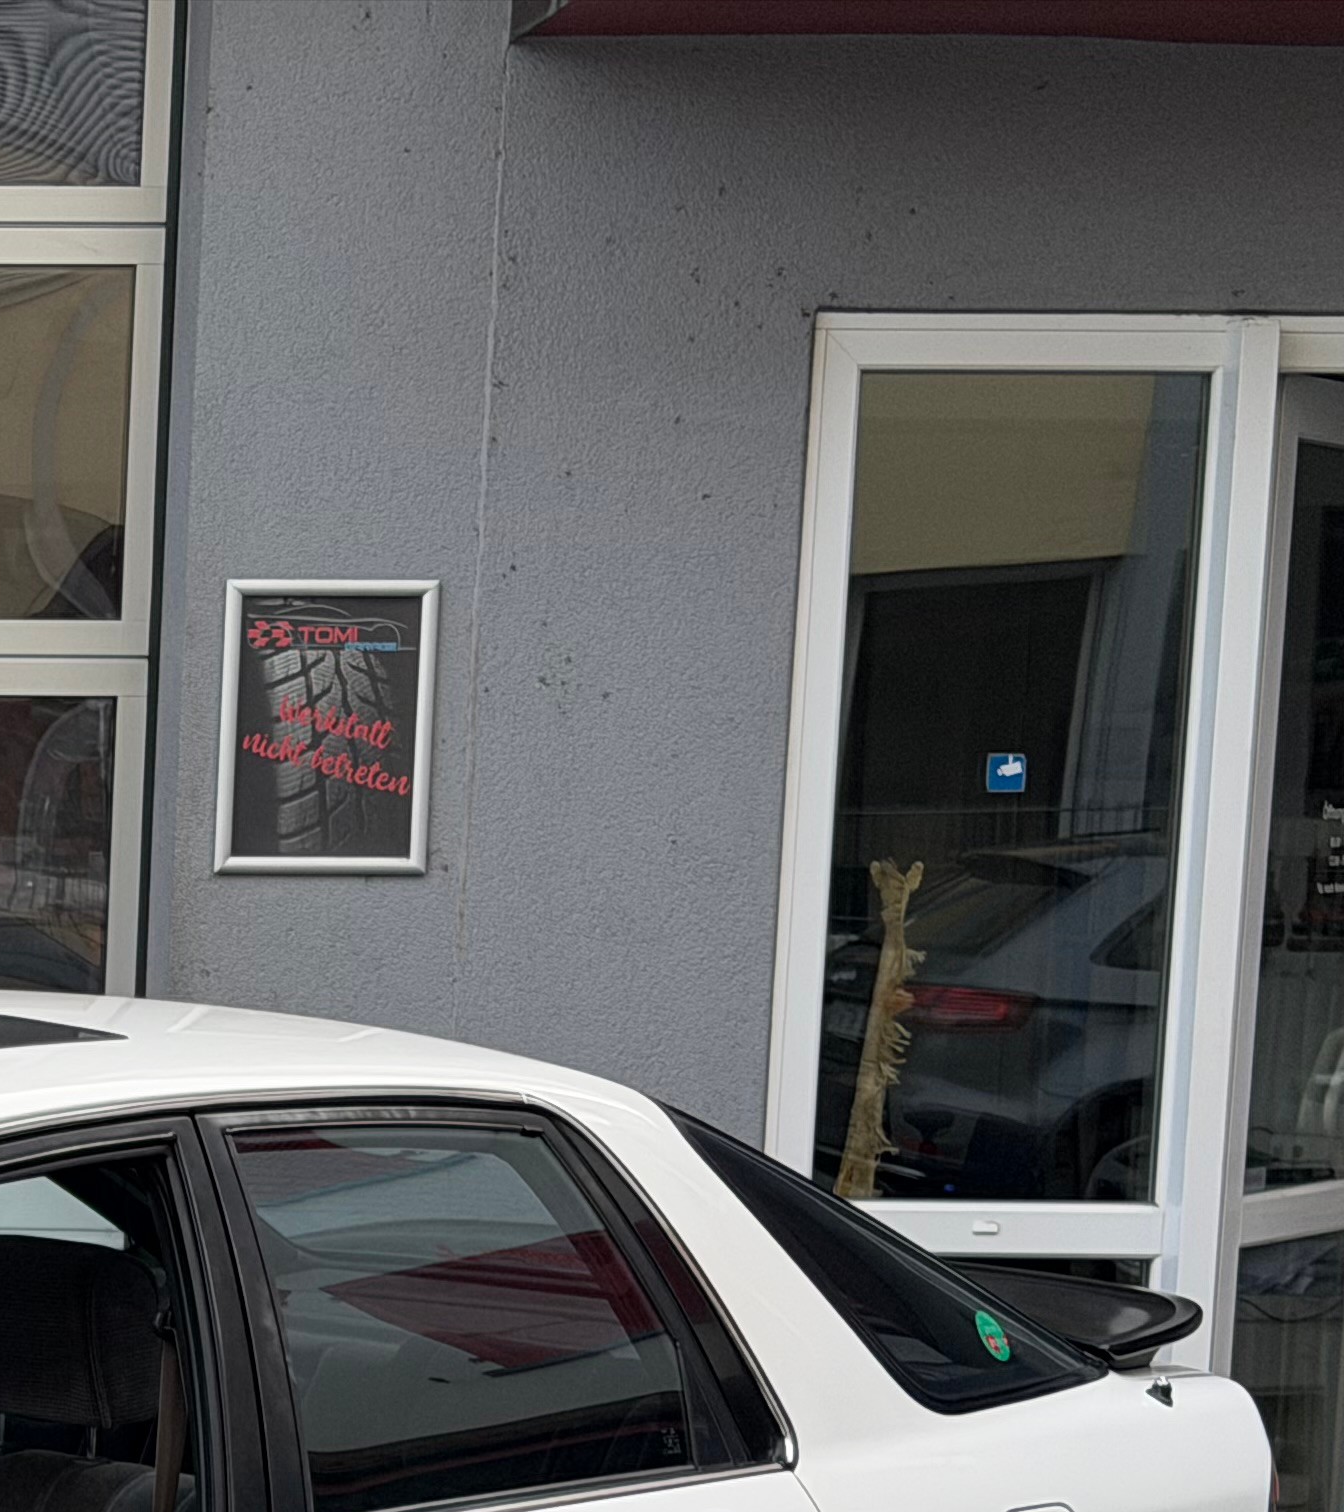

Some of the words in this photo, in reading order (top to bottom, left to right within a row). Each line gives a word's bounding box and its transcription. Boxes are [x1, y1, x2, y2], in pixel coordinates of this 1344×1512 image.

[298, 626, 359, 643] TOMI
[279, 695, 393, 748] Werkstatt
[242, 733, 306, 765] nicht
[311, 744, 409, 795] betreten
